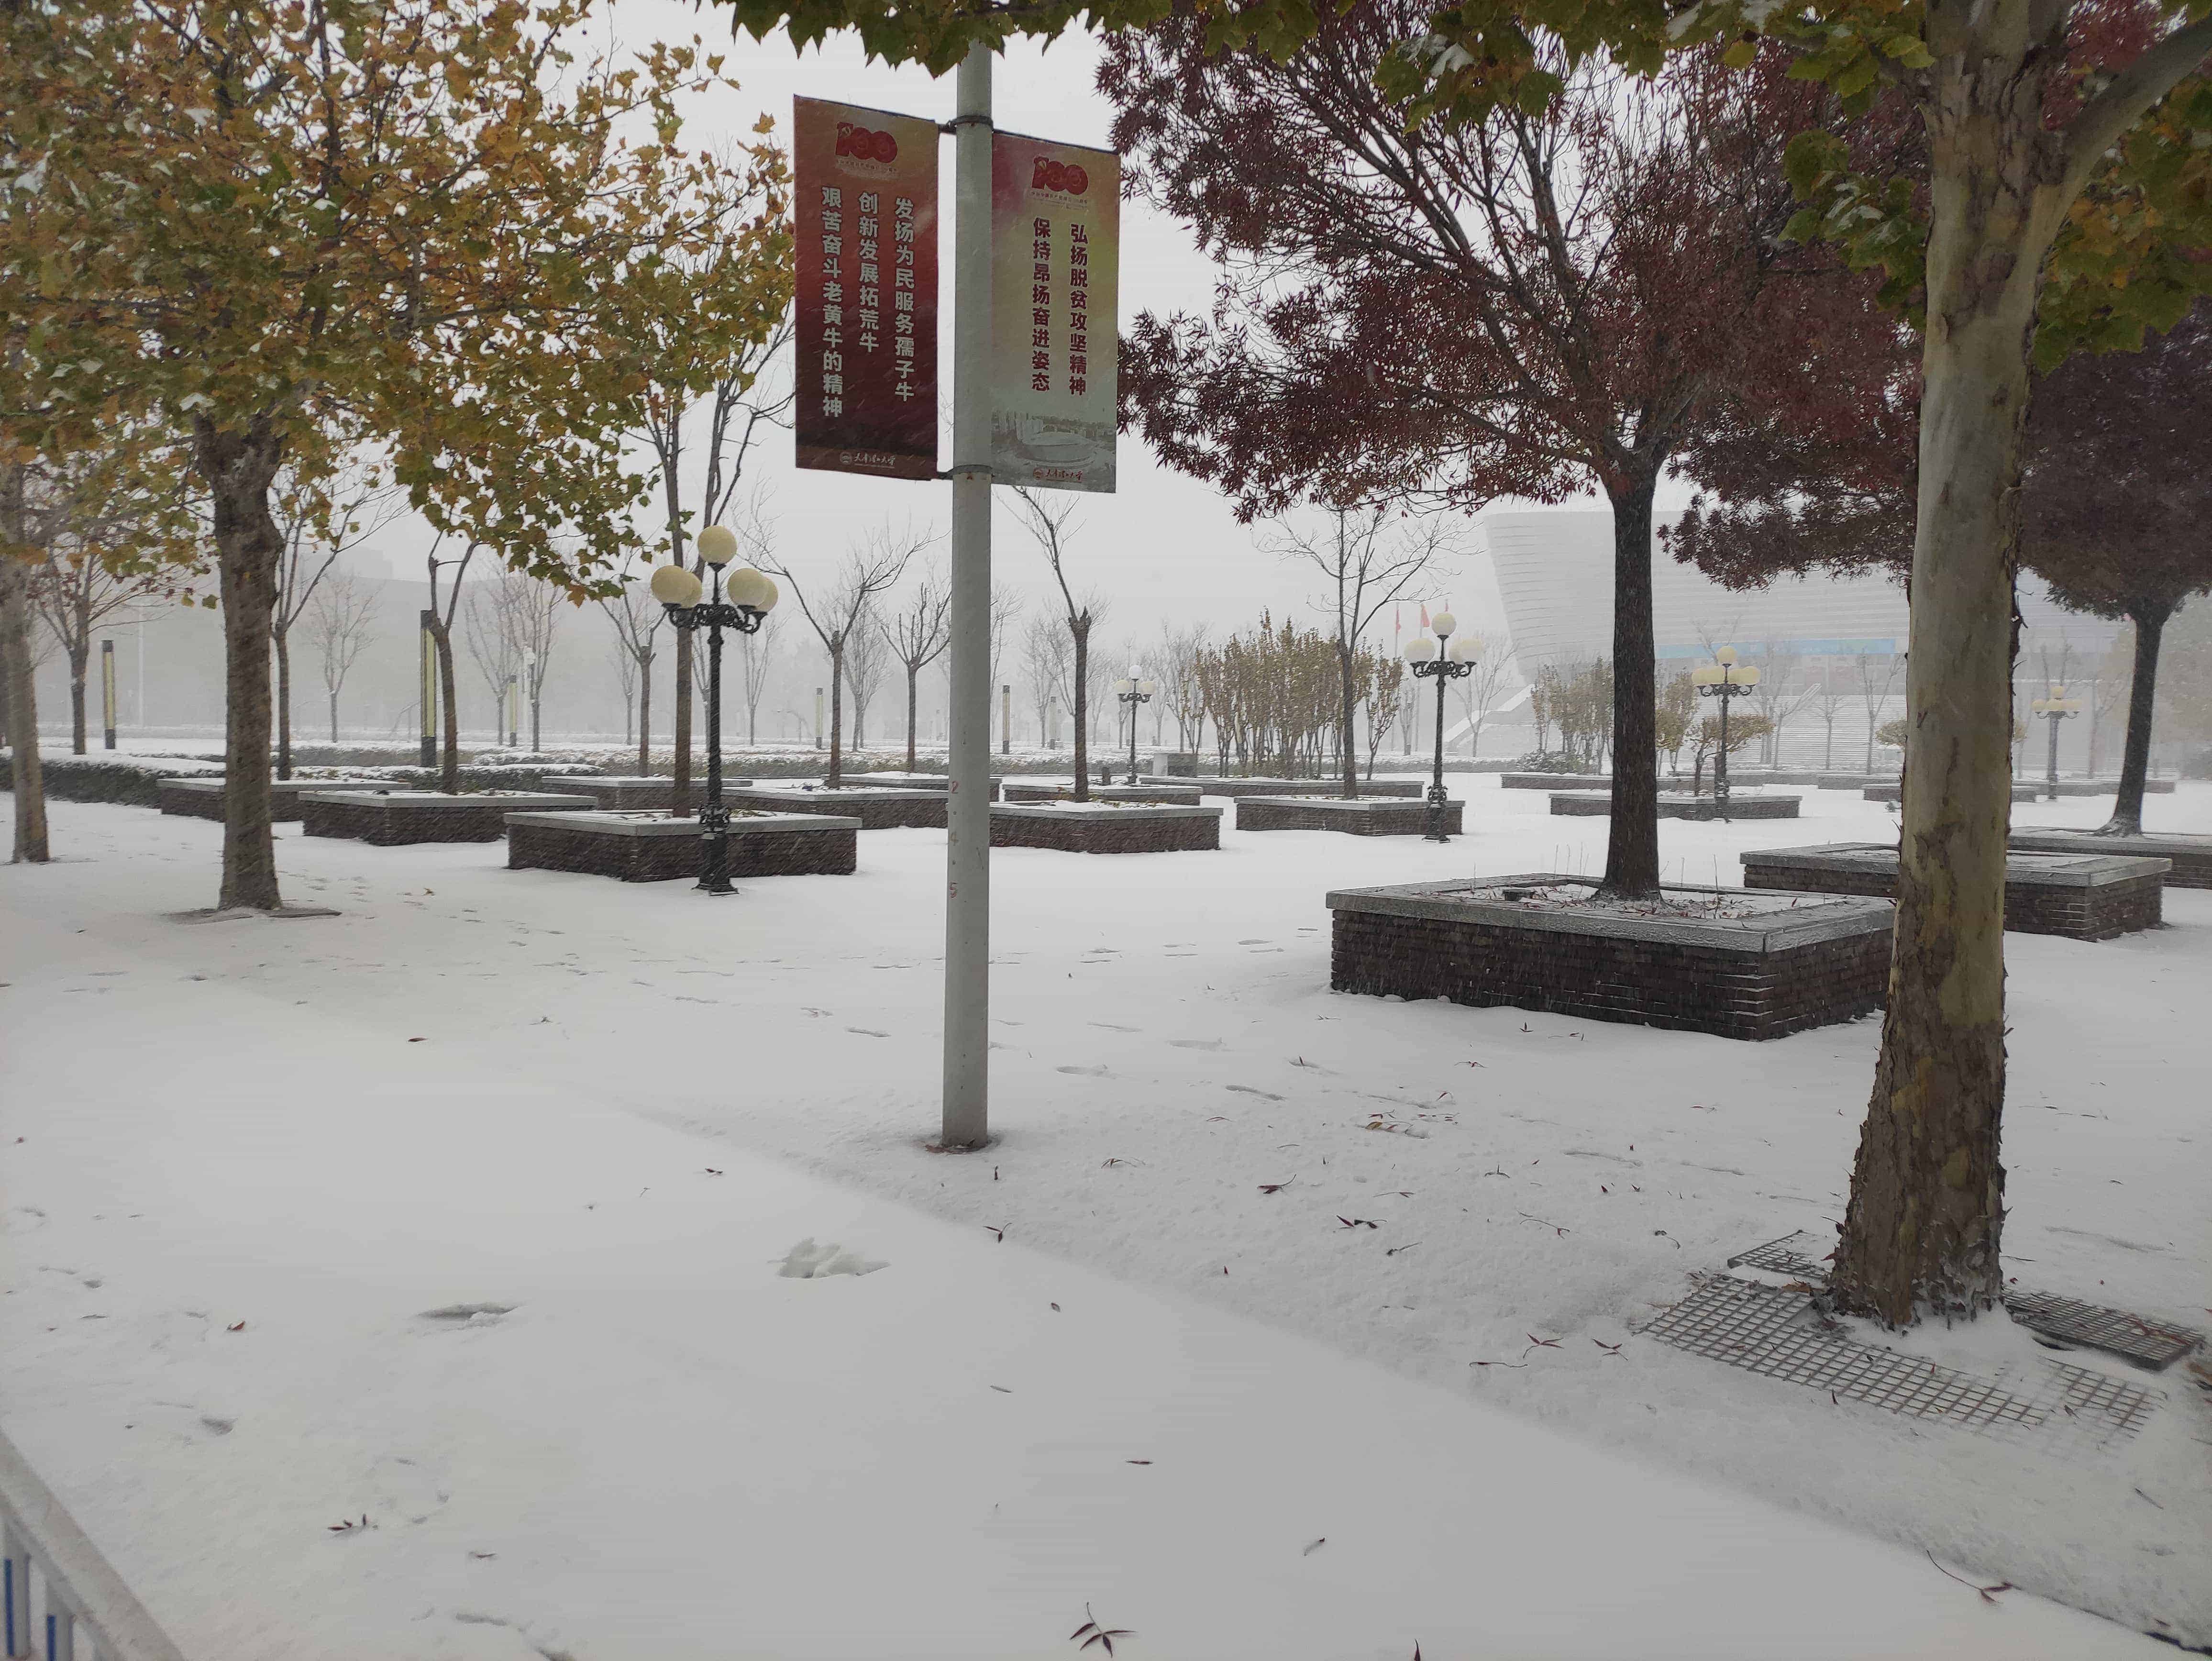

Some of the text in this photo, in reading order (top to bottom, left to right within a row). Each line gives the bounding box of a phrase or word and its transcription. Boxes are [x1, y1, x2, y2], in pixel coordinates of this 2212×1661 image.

[821, 187, 843, 417] 艰苦奋斗老黄牛的精神
[858, 191, 879, 353] 创新发展拓荒牛
[894, 197, 915, 402] 发扬为民服务孺子牛
[1031, 217, 1051, 392] 保持昂扬奋进姿态
[1069, 223, 1088, 397] 弘扬脱贫攻坚精神
